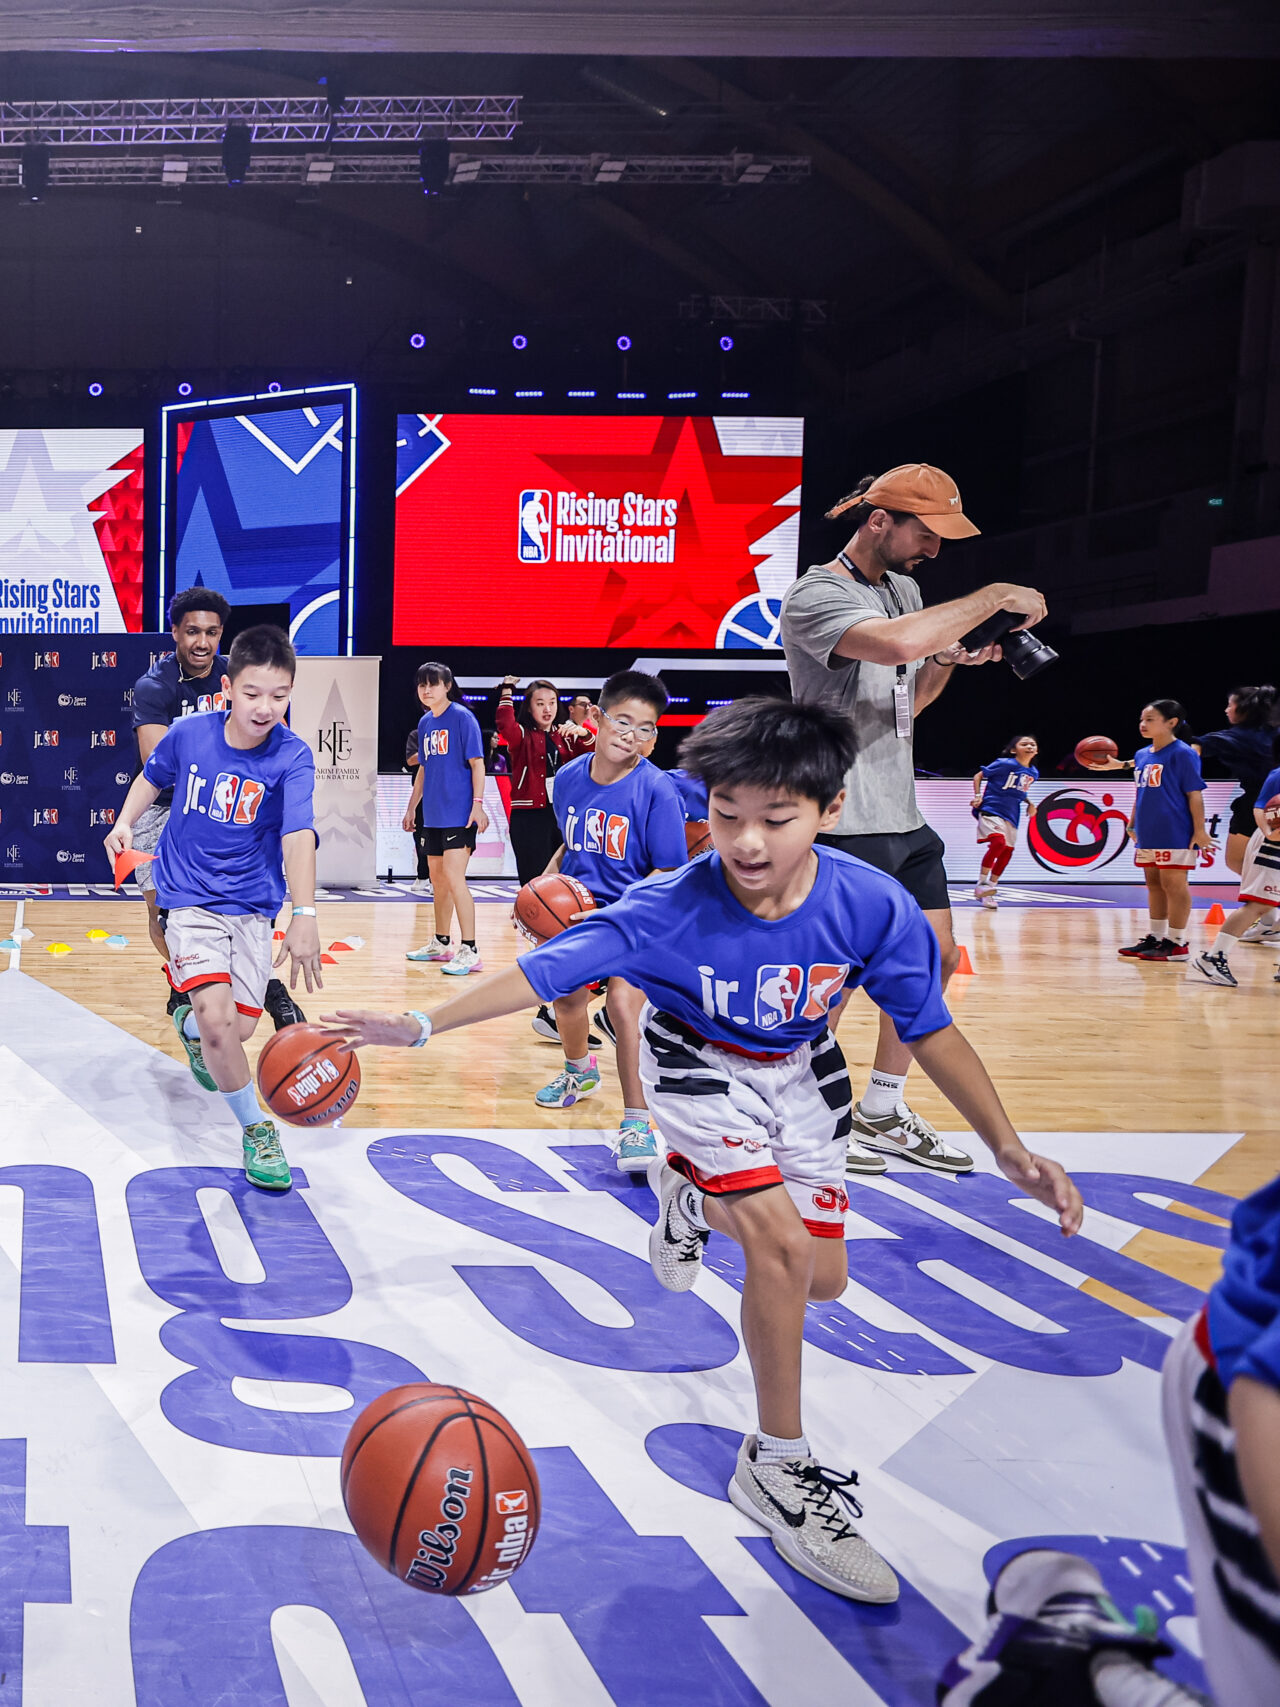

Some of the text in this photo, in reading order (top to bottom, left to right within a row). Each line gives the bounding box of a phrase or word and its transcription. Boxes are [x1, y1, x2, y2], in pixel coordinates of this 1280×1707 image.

[556, 491, 678, 532] Rising Stars
[523, 546, 539, 559] NBA
[555, 528, 676, 563] Invitational
[52, 578, 100, 608] Stars
[183, 764, 207, 815] jr.
[697, 965, 750, 1025] jr.
[761, 1011, 778, 1027] NBA
[871, 1077, 900, 1089] VANS
[406, 1467, 473, 1590] Wilson
[481, 1515, 528, 1582] jr.nba
